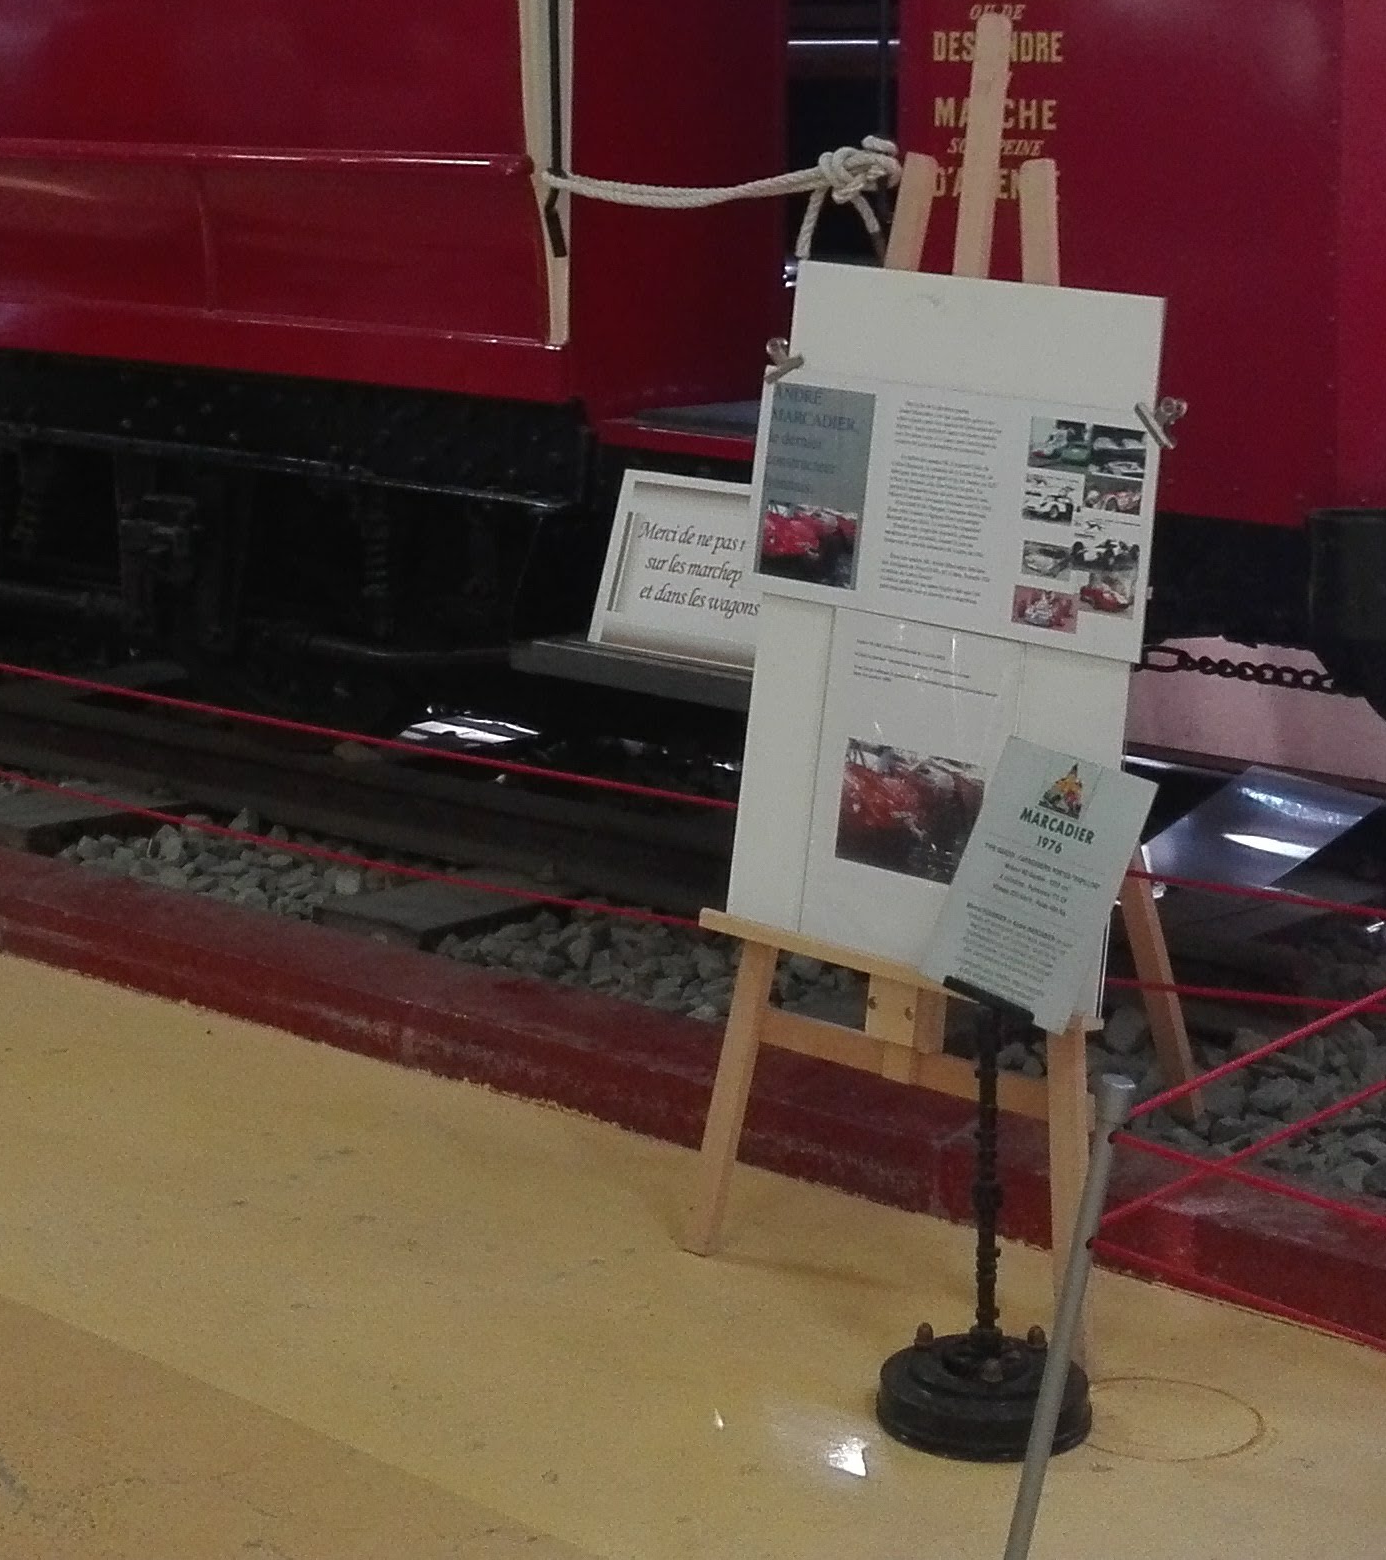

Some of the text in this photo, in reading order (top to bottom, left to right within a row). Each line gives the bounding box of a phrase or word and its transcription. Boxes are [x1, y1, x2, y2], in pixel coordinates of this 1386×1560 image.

[933, 30, 1064, 63] DESNDRE
[934, 96, 1057, 131] MACHE
[638, 521, 677, 543] Merci
[678, 525, 695, 545] de
[696, 534, 713, 547] ne
[710, 534, 739, 555] pas
[645, 553, 743, 589] sur les marchep
[639, 582, 761, 620] et dans les wagons
[1019, 807, 1095, 845] MARCADIER
[1036, 835, 1063, 855] 1976
